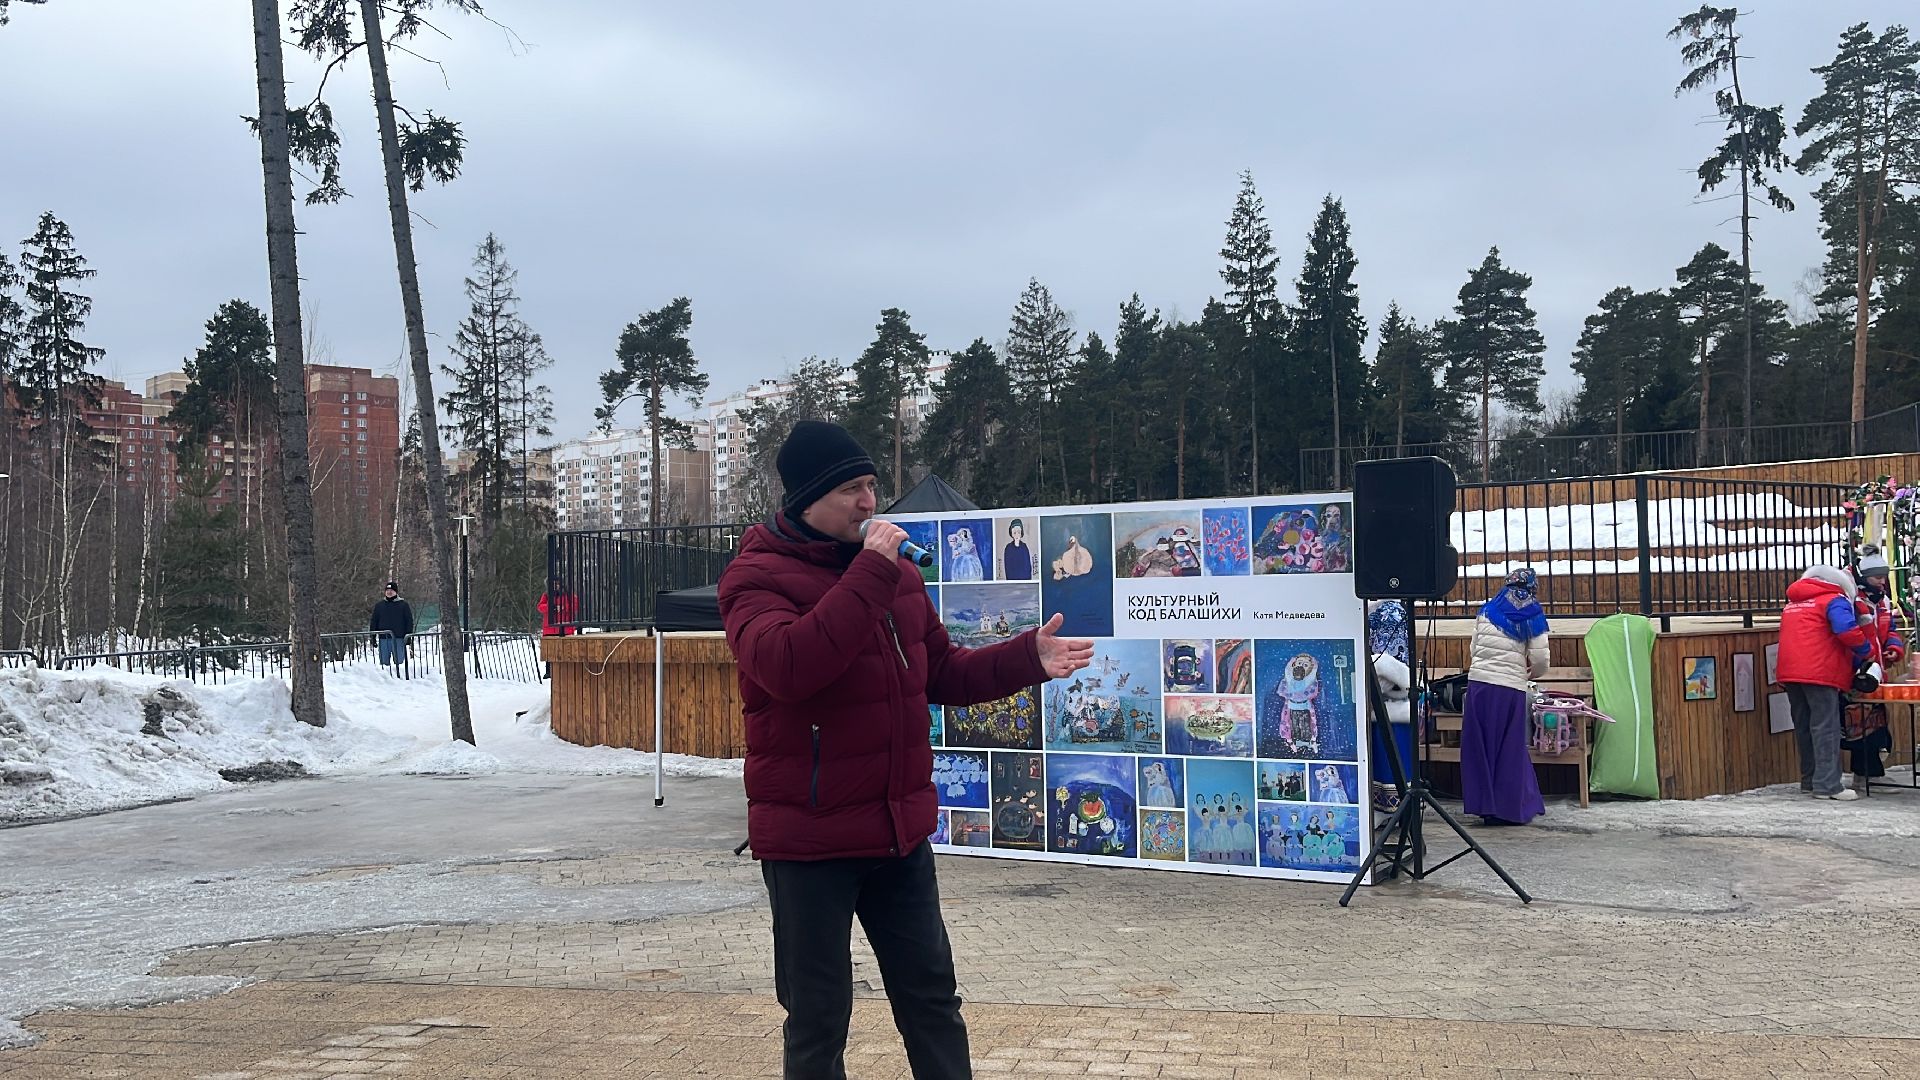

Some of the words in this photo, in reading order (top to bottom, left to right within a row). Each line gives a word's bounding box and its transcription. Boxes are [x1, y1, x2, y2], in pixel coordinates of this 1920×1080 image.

[1128, 592, 1219, 607] КУЛЬТУРНЫЙ
[1128, 608, 1157, 621] КОД
[1160, 608, 1241, 620] БАЛАШИХИ
[1253, 611, 1274, 620] Катя
[1275, 611, 1326, 620] Медведева
